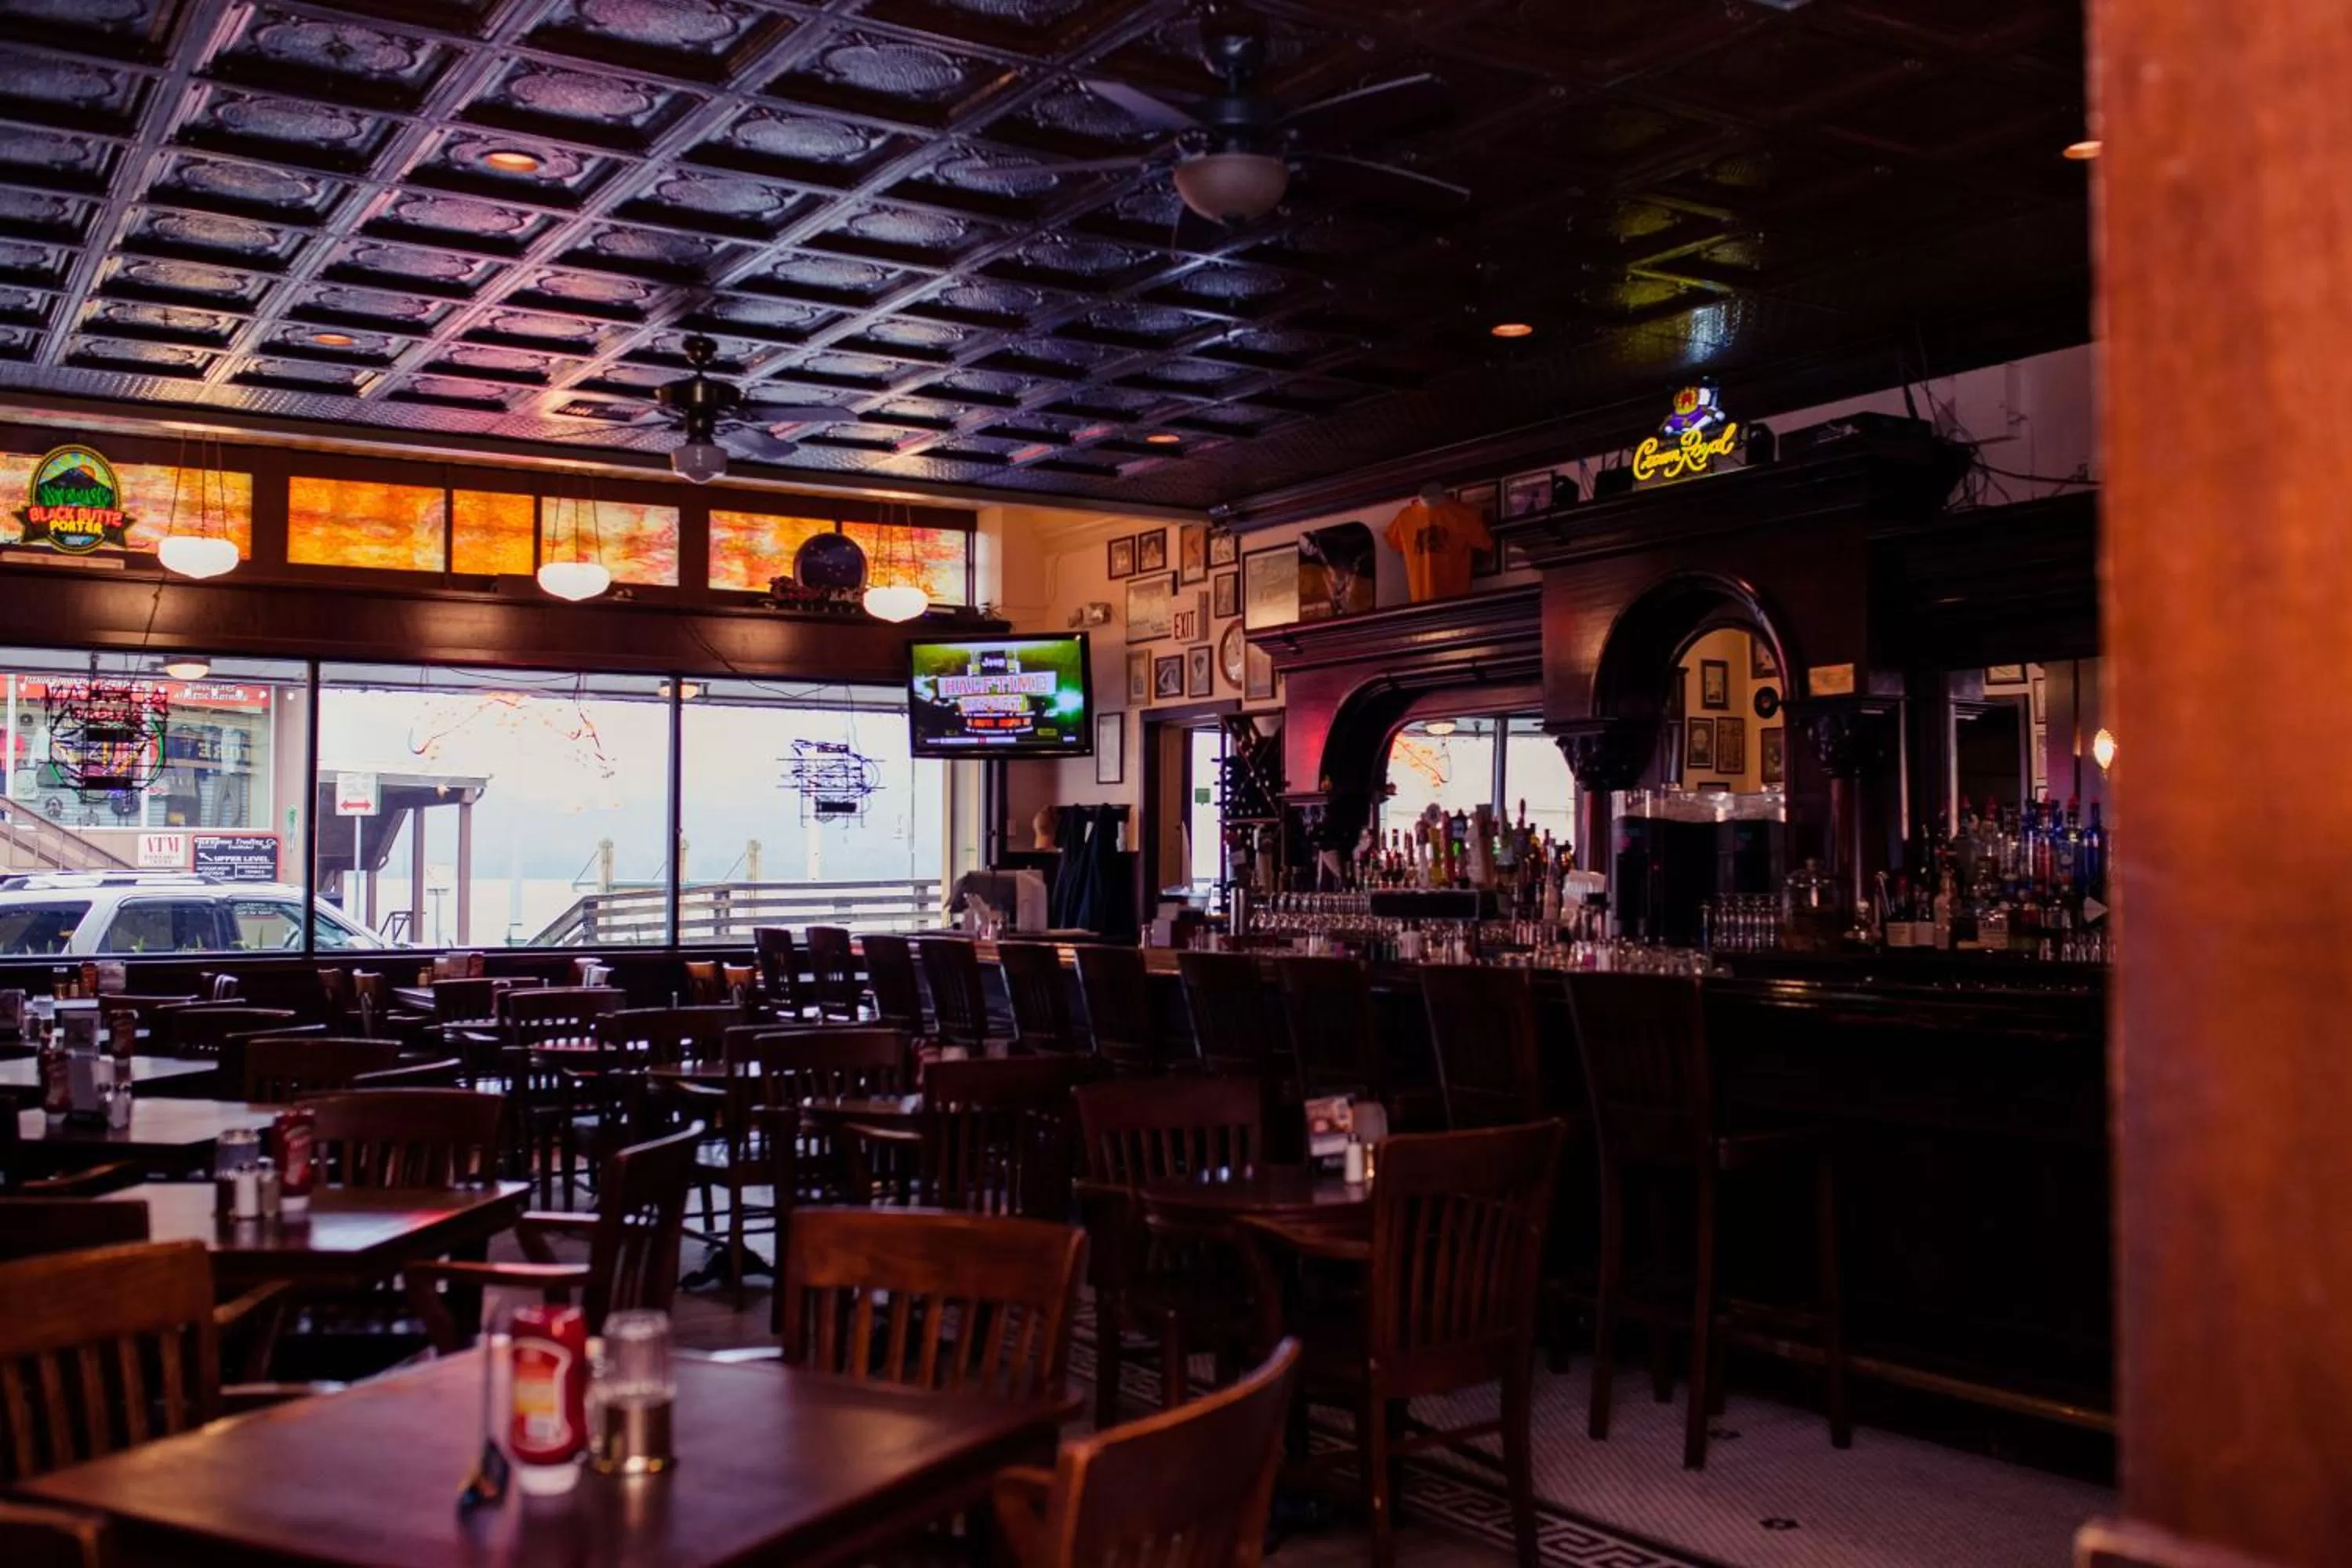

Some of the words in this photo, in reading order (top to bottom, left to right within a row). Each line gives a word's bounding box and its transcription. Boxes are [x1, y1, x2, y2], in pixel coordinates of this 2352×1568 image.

[28, 506, 75, 523] BLACK
[78, 506, 124, 528] BUTTE
[49, 520, 103, 534] PORTER
[1174, 610, 1196, 641] EXIT
[944, 676, 1047, 695] HALFTIME
[146, 837, 179, 853] ATM
